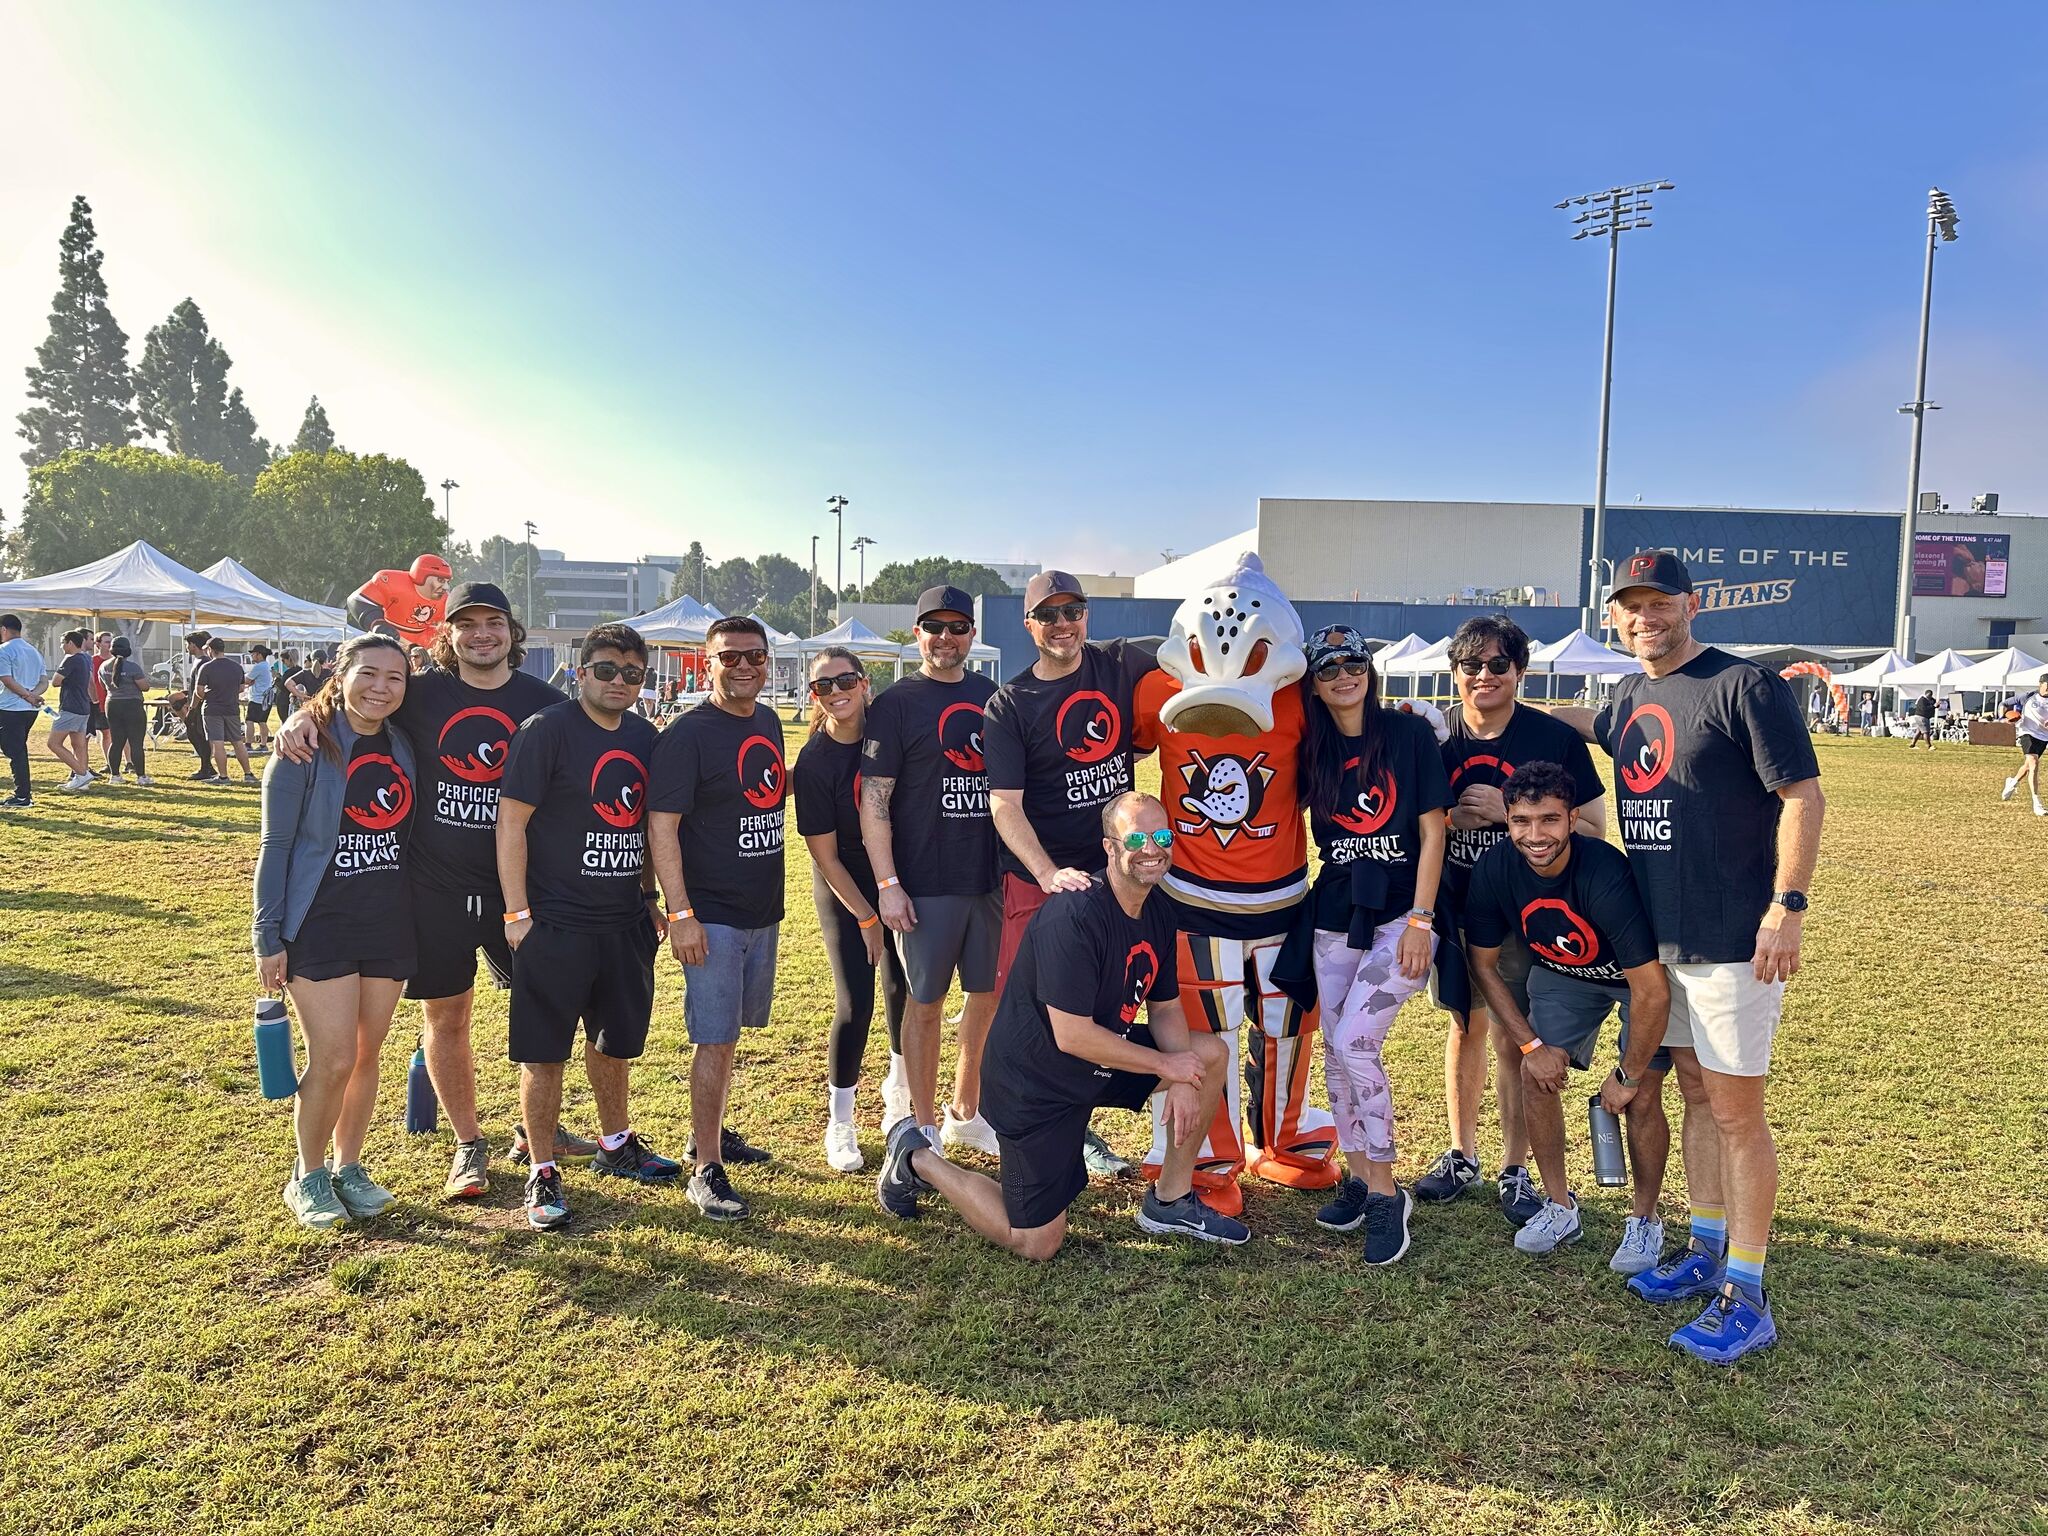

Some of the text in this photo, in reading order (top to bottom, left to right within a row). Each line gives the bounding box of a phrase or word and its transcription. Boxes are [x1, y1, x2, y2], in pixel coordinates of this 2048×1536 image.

[1635, 546, 1849, 567] OME OF THE
[1630, 557, 1656, 577] P
[1693, 580, 1791, 610] TITANS
[1065, 752, 1127, 787] PERFICIENT
[437, 781, 500, 803] PERFICIEN
[943, 776, 990, 792] PERFICIE
[1066, 767, 1129, 802] GIVING
[437, 798, 497, 821] GIVIN
[941, 792, 991, 810] GIVIN
[1621, 799, 1672, 818] ERFICIENT
[434, 814, 462, 827] Employee
[462, 821, 491, 830] Resource
[942, 811, 969, 819] Employee
[1624, 820, 1672, 841] IVING
[1450, 840, 1490, 862] GIV
[1653, 843, 1672, 851] Group
[582, 849, 645, 868] GIVING
[581, 868, 612, 877] Employee
[1093, 1069, 1112, 1078] Emplo
